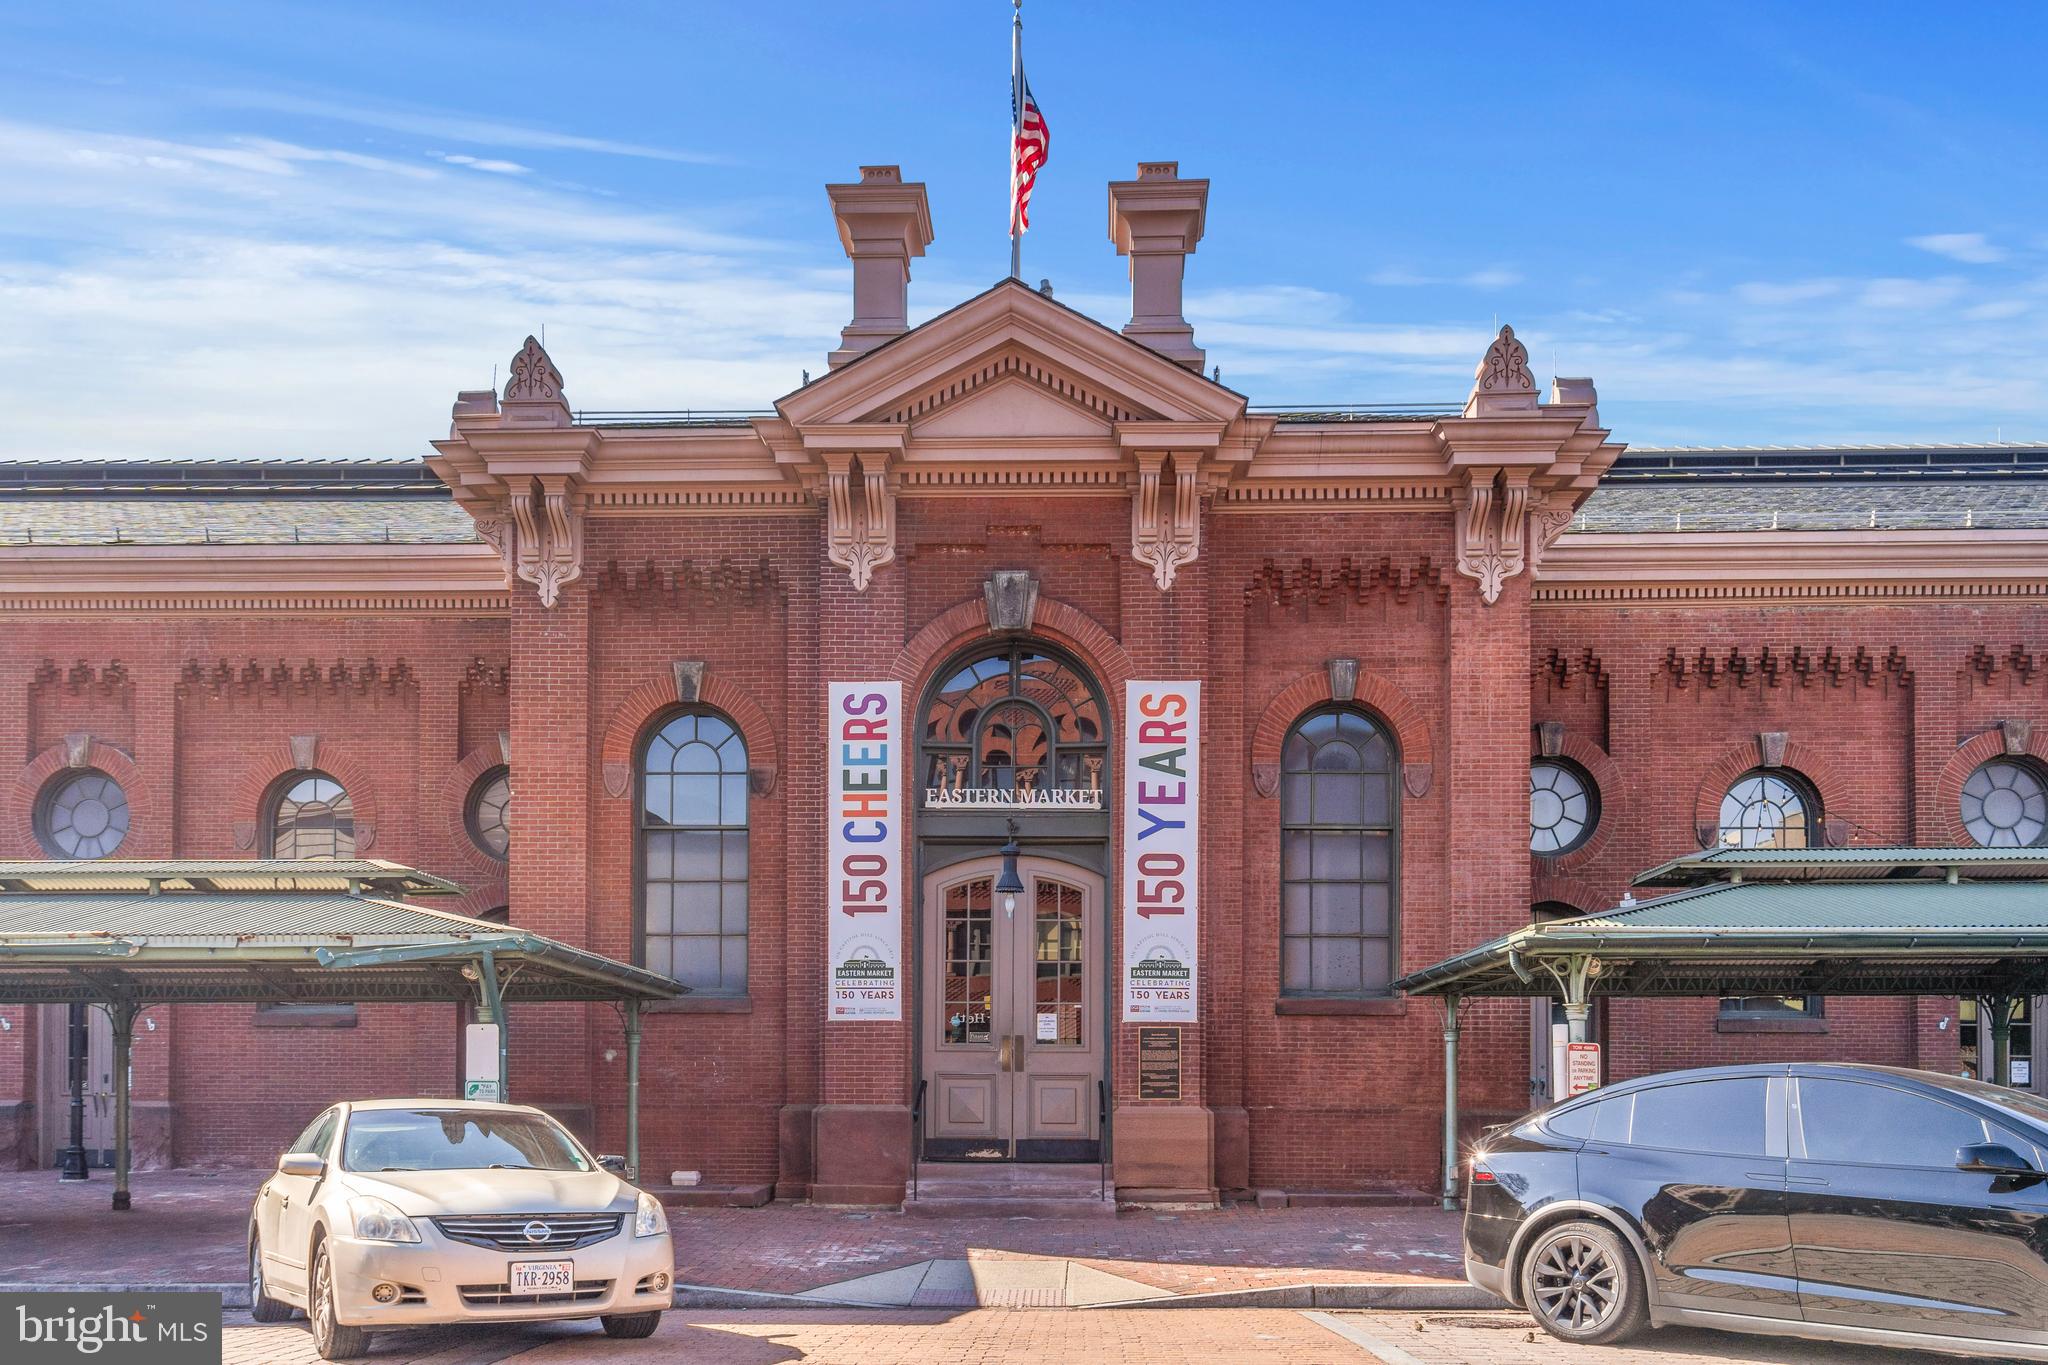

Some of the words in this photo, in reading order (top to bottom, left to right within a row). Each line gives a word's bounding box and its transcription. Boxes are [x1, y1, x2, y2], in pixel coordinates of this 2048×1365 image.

[843, 693, 888, 843] CHEERS
[1138, 694, 1187, 841] YEARS
[925, 788, 1015, 804] EASTERN
[1019, 788, 1103, 804] MARKET
[843, 854, 888, 917] 150
[1137, 853, 1185, 920] 150
[835, 990, 855, 999] 150
[861, 990, 895, 999] YEARS
[1130, 990, 1150, 999] 150
[1155, 990, 1190, 999] YEARS
[516, 1270, 570, 1287] TKR-2958
